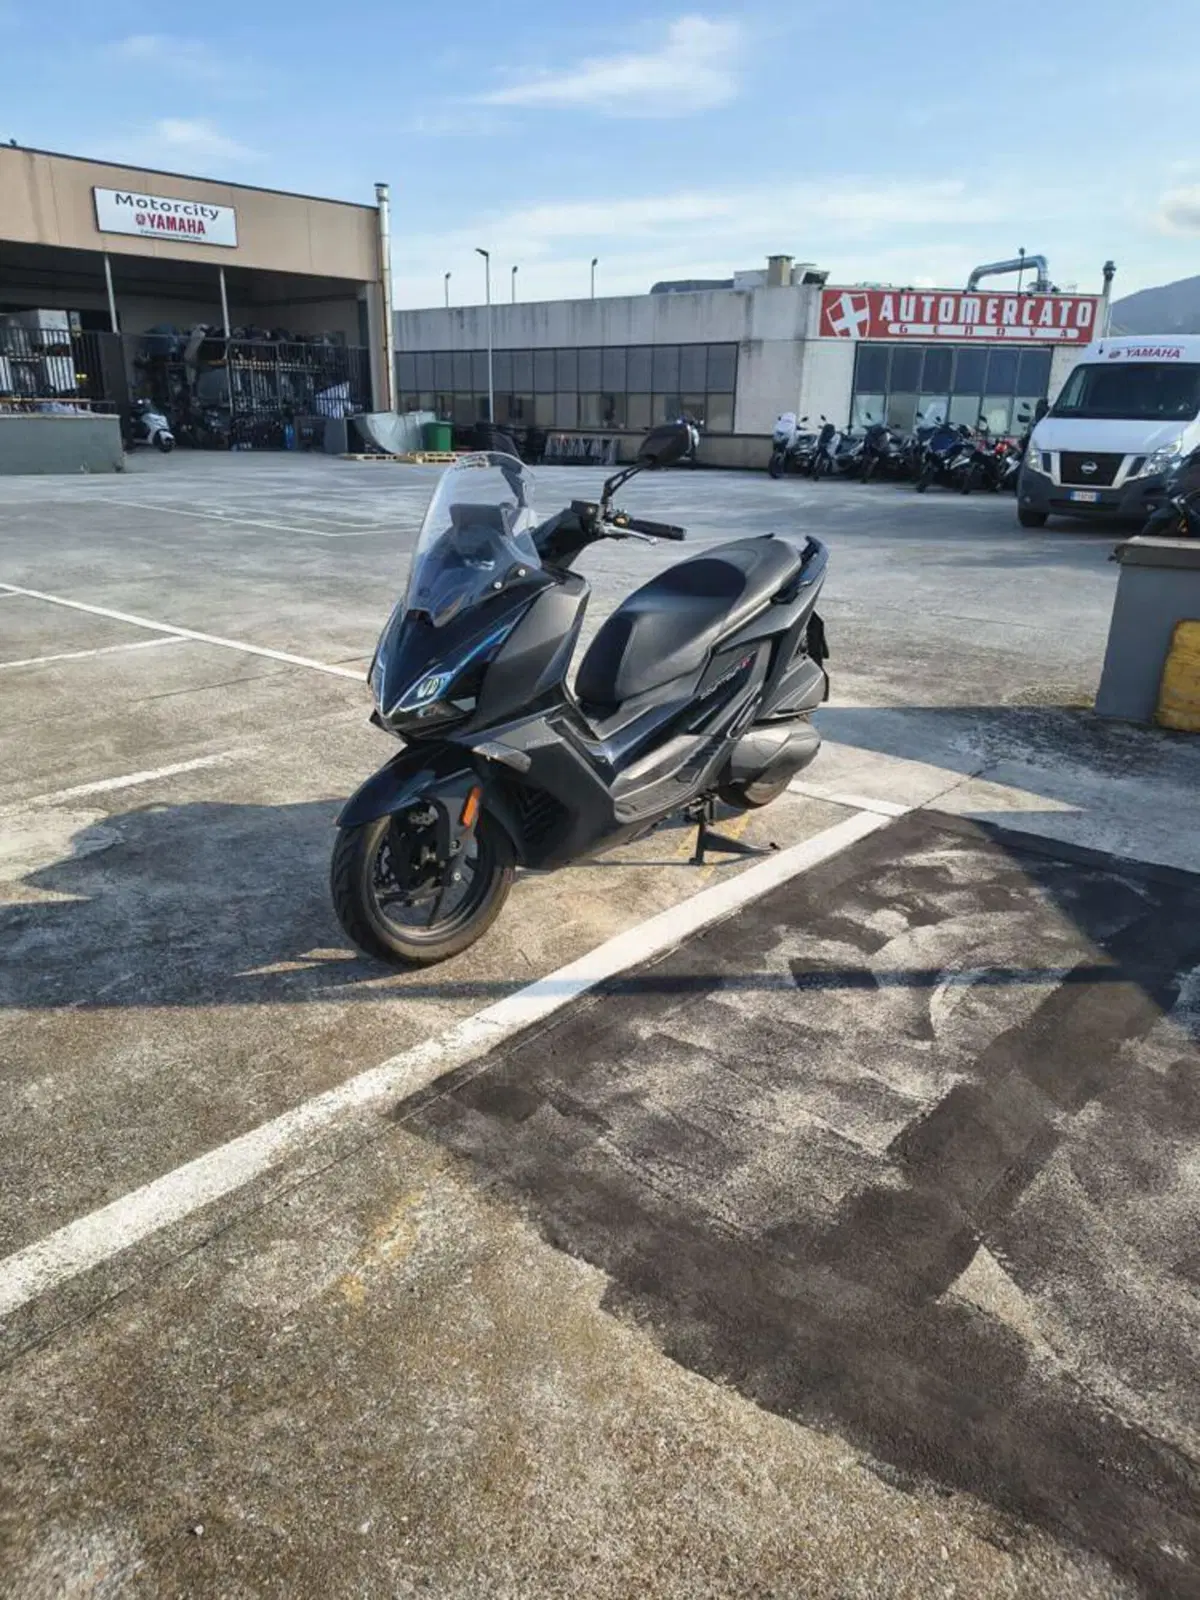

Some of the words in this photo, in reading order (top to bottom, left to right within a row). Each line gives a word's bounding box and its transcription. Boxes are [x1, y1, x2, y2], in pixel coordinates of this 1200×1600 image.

[115, 193, 219, 221] Motorcity
[147, 213, 206, 234] YAMAHA
[879, 294, 1092, 327] AUTOMERCATO
[898, 325, 1069, 338] GENOVA
[1125, 347, 1181, 359] YAMAHA
